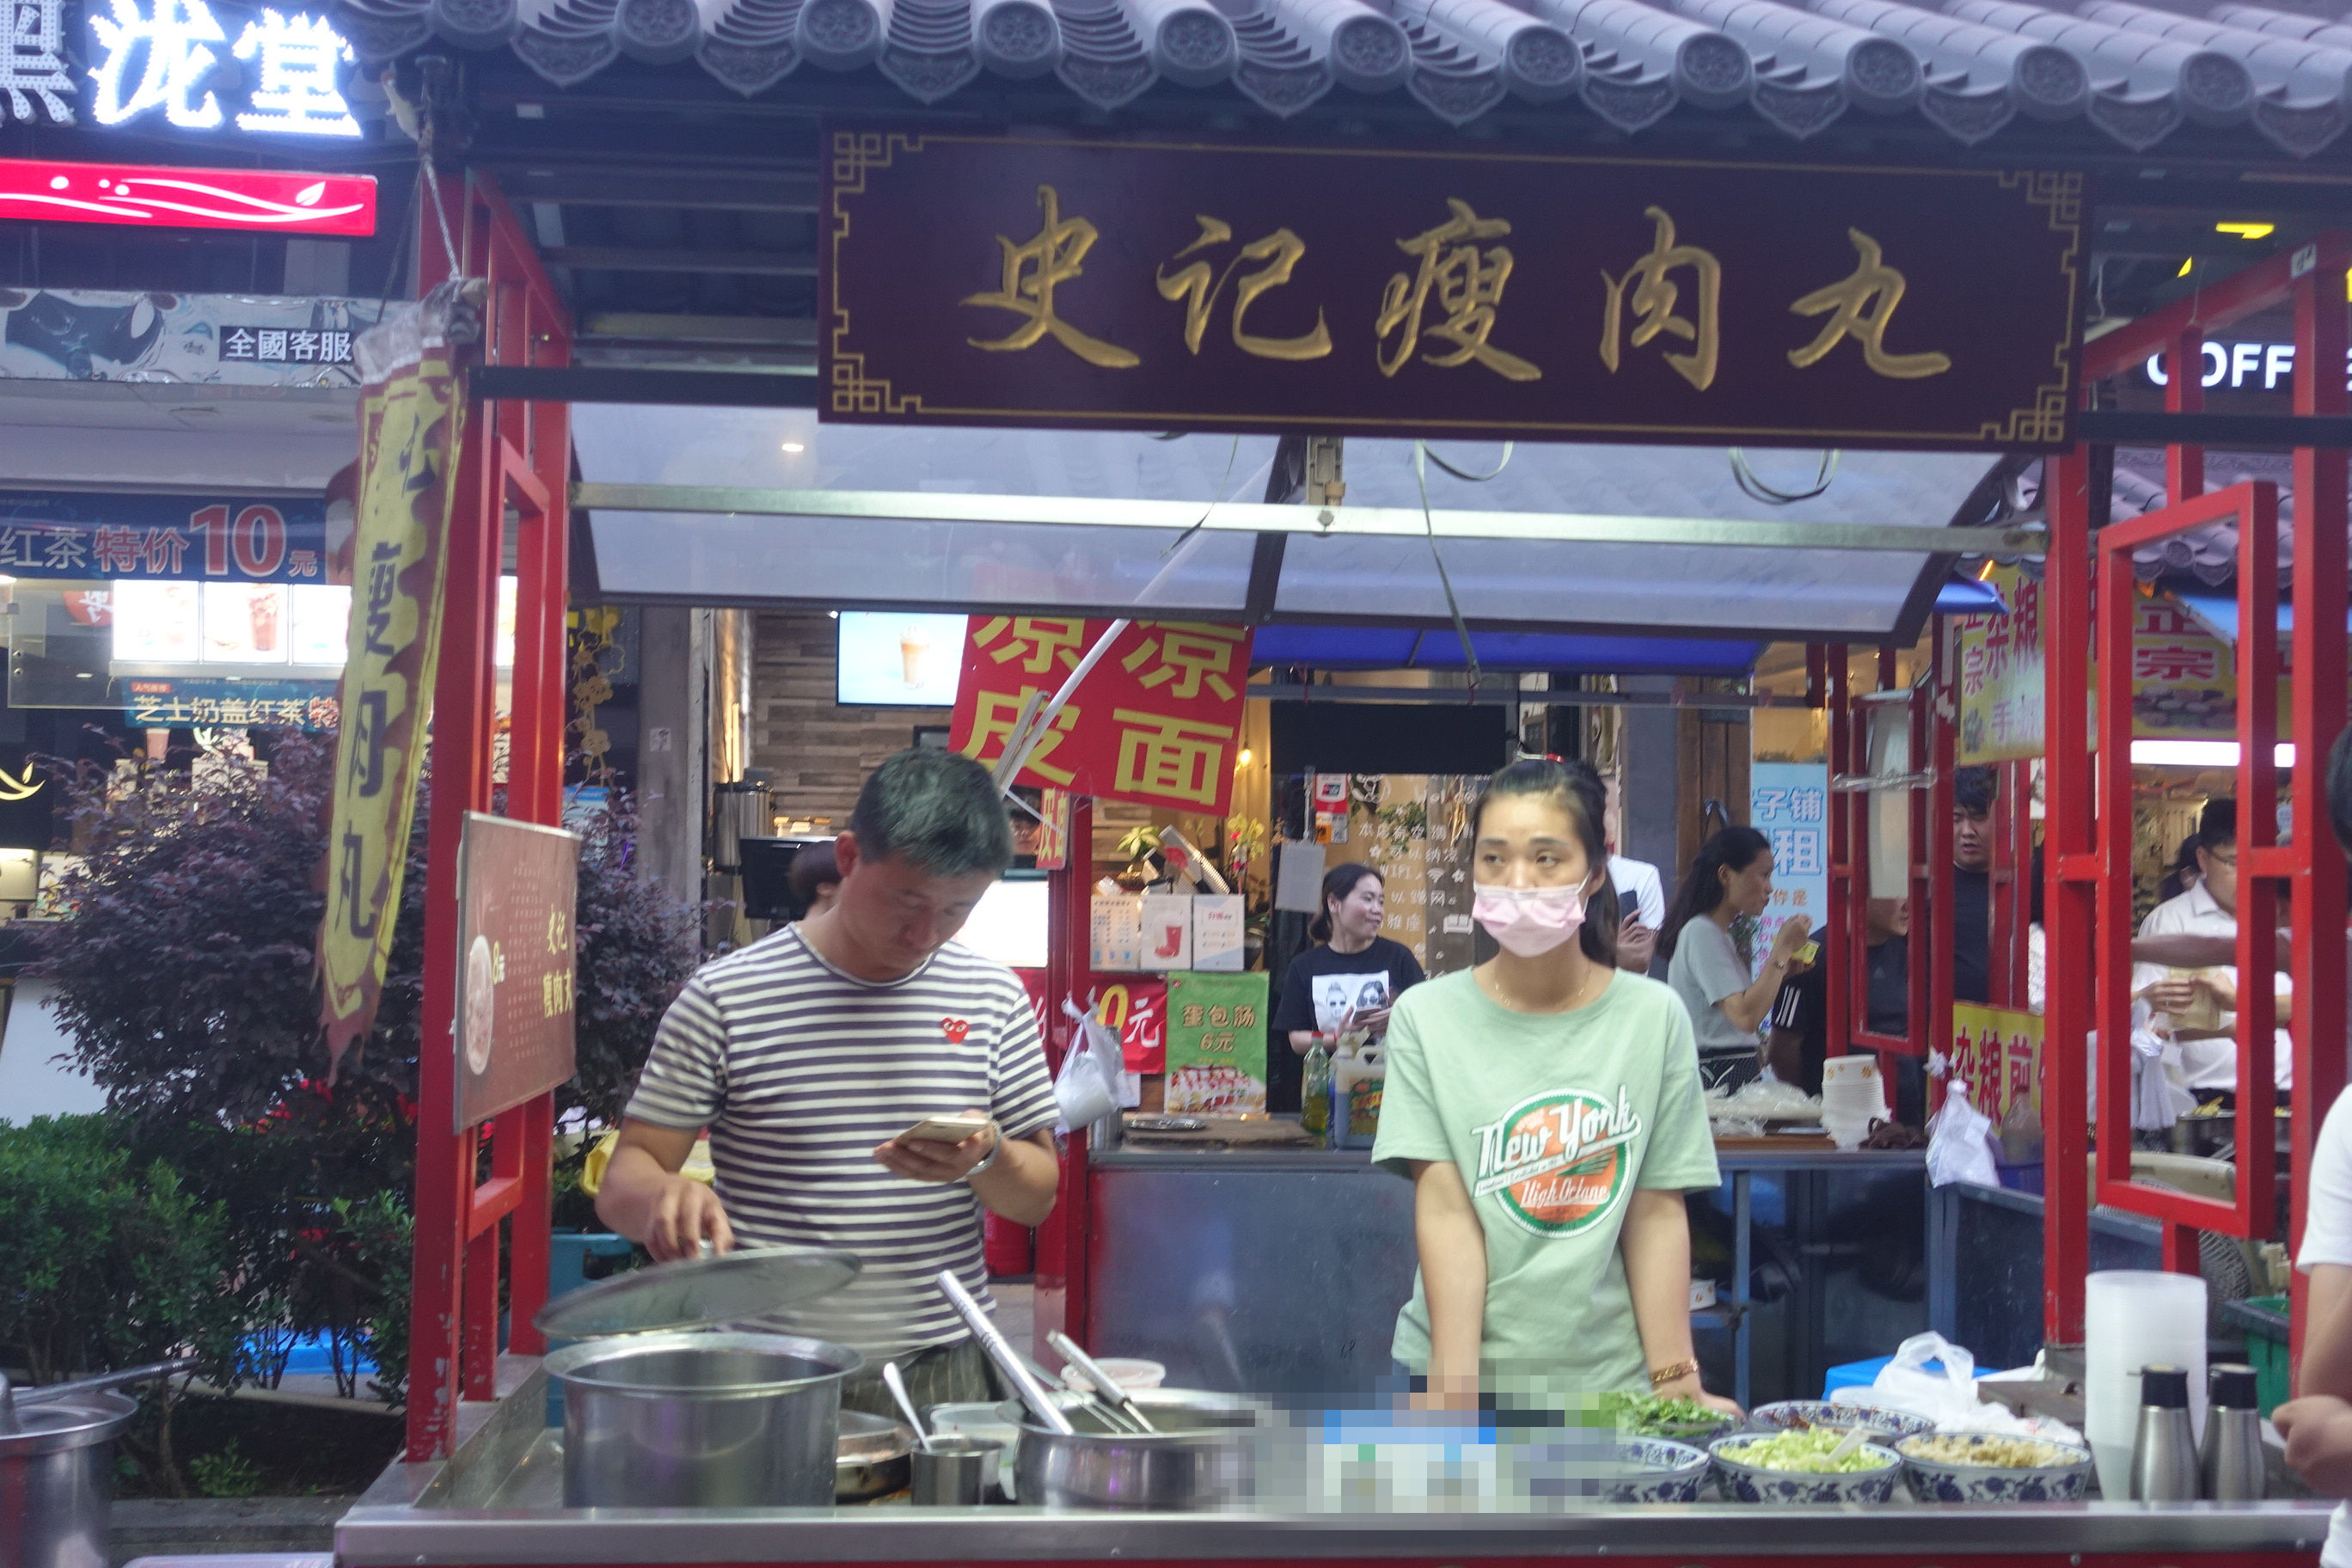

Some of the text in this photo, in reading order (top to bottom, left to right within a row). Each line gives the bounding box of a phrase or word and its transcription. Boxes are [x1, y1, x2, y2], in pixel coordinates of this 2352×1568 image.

[959, 185, 1951, 390] 史记瘦肉丸
[225, 328, 353, 363] 全國客服
[2135, 605, 2216, 682] 正宗
[1182, 1004, 1255, 1028] 蛋包肠
[1200, 1032, 1236, 1053] 6元
[1955, 1024, 2044, 1128] 杂粮煎
[1471, 1119, 1553, 1178] New
[1549, 1084, 1642, 1159] York
